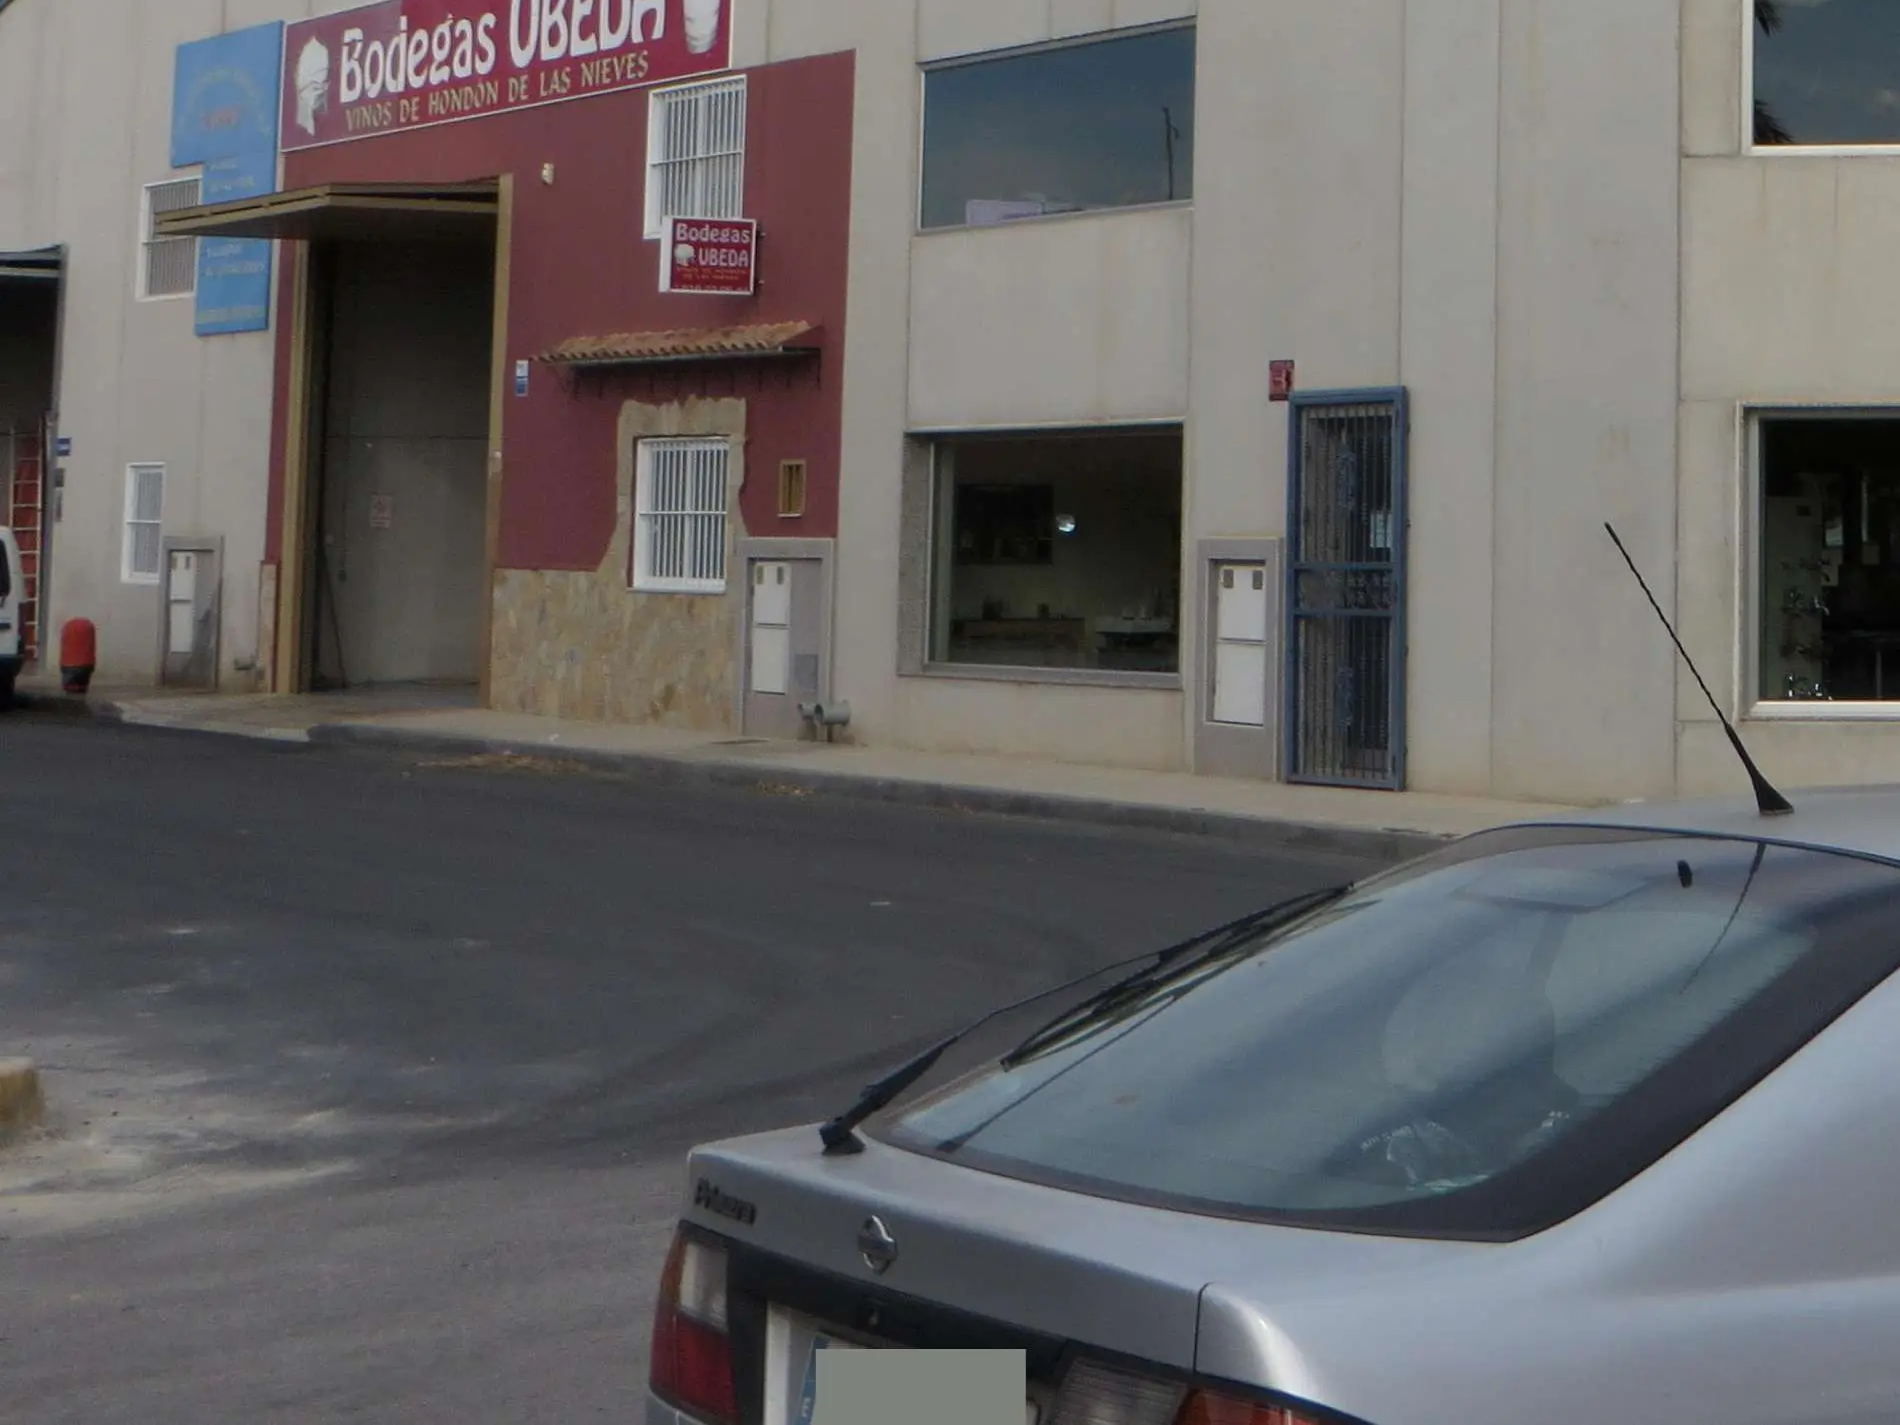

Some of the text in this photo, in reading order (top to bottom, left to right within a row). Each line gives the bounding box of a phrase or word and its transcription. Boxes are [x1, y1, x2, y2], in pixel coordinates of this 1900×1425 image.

[340, 13, 496, 103] Bodegas
[345, 102, 392, 132] VINOS
[400, 96, 421, 124] DE
[508, 75, 529, 103] DE
[540, 67, 571, 98] LAS
[581, 50, 649, 88] NIEVES
[676, 222, 750, 244] Bodegas
[698, 247, 749, 267] UBEDA
